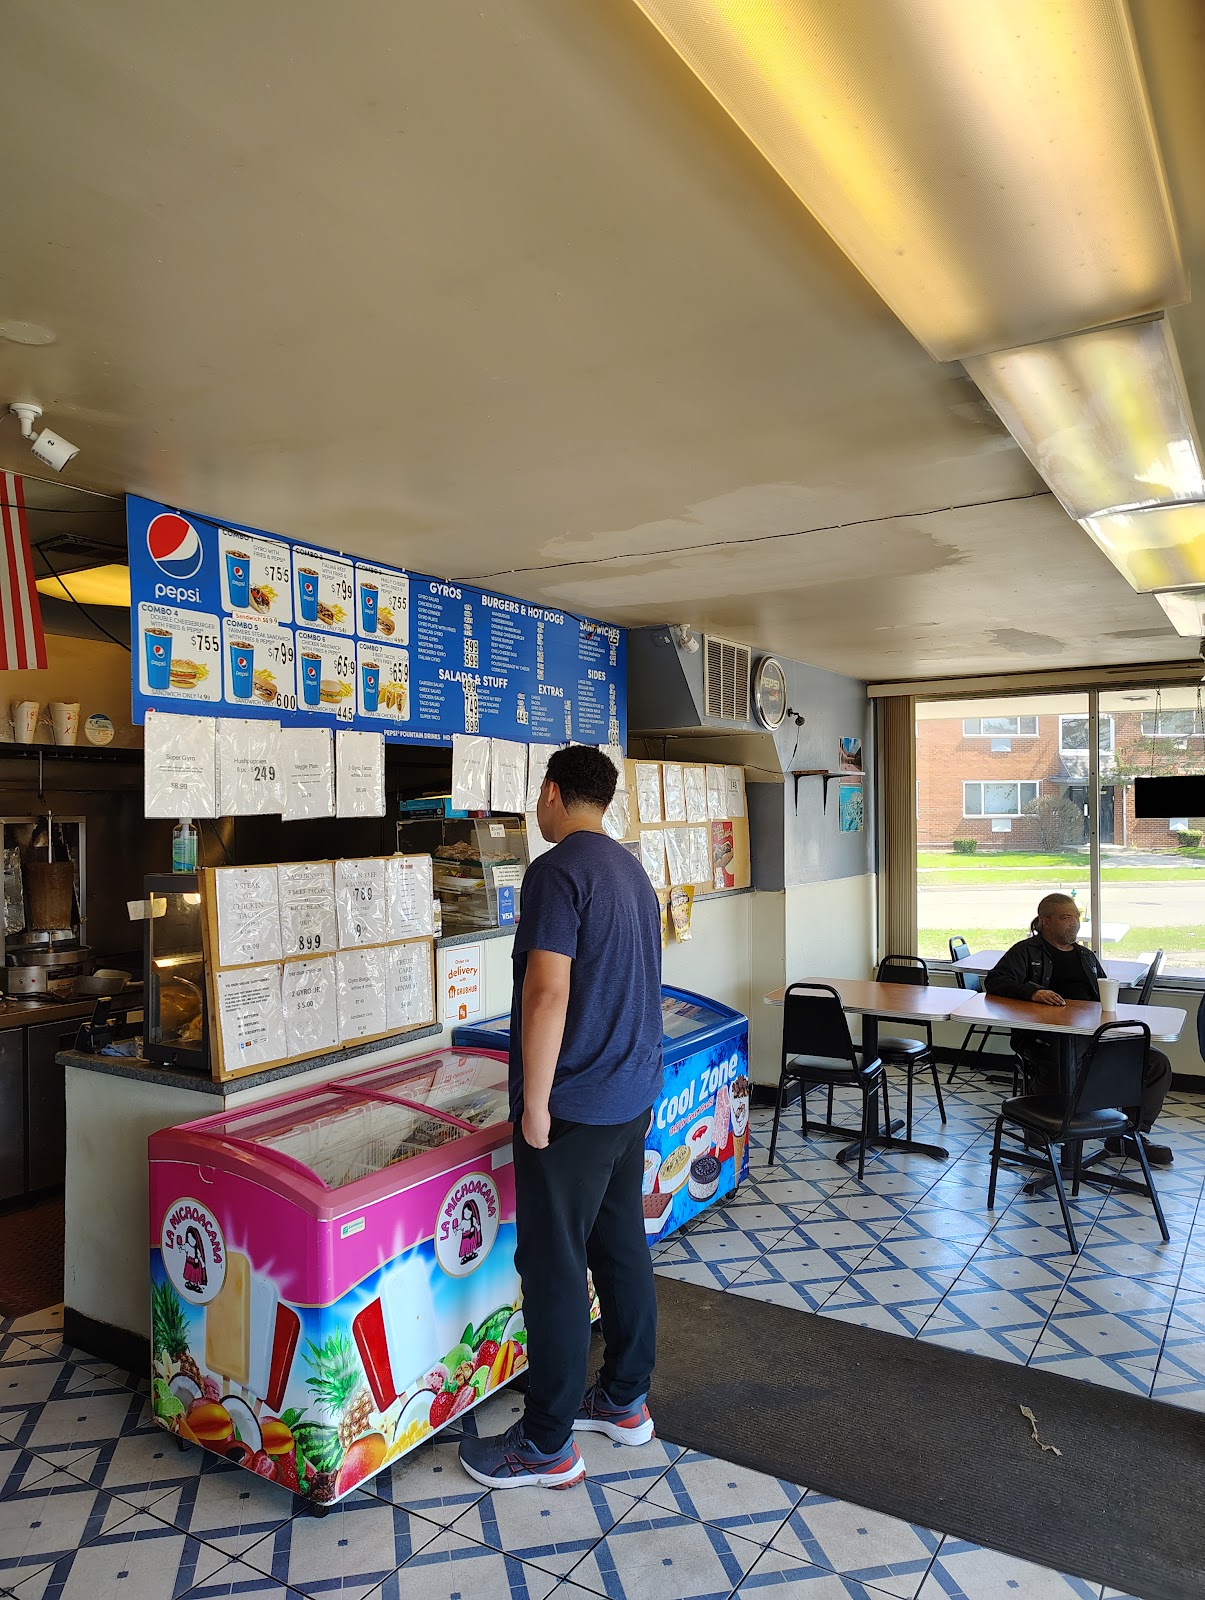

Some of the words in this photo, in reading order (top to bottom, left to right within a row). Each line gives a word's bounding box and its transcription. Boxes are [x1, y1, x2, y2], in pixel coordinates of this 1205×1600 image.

[154, 583, 201, 603] pepsi
[430, 582, 462, 600] GYROS
[142, 604, 172, 615] COMBO
[481, 595, 519, 613] BURGERS
[521, 605, 526, 615] &
[528, 607, 543, 620] HOT
[544, 611, 564, 625] DOGS
[151, 614, 172, 623] DOUBLE
[174, 618, 215, 629] CHEESEBURGER
[236, 613, 261, 622] Sandwich
[226, 620, 253, 630] COMBO
[299, 632, 321, 641] COMBO
[360, 643, 378, 651] COMBO
[588, 669, 606, 680] SIDES
[475, 674, 481, 685] &
[483, 676, 508, 689] STUFF
[761, 676, 780, 690] PEPSI
[151, 689, 182, 697] SANDWICH
[538, 684, 564, 697] EXTRAS
[299, 935, 320, 950] 899
[448, 966, 478, 979] delivery
[296, 988, 312, 997] GYRO
[457, 985, 477, 996] GRUBHUB
[657, 1079, 695, 1130] Cool
[440, 1220, 450, 1241] LA
[445, 1180, 496, 1218] MICHOACANA
[165, 1230, 174, 1249] LA
[170, 1206, 222, 1264] MICHOACANA
